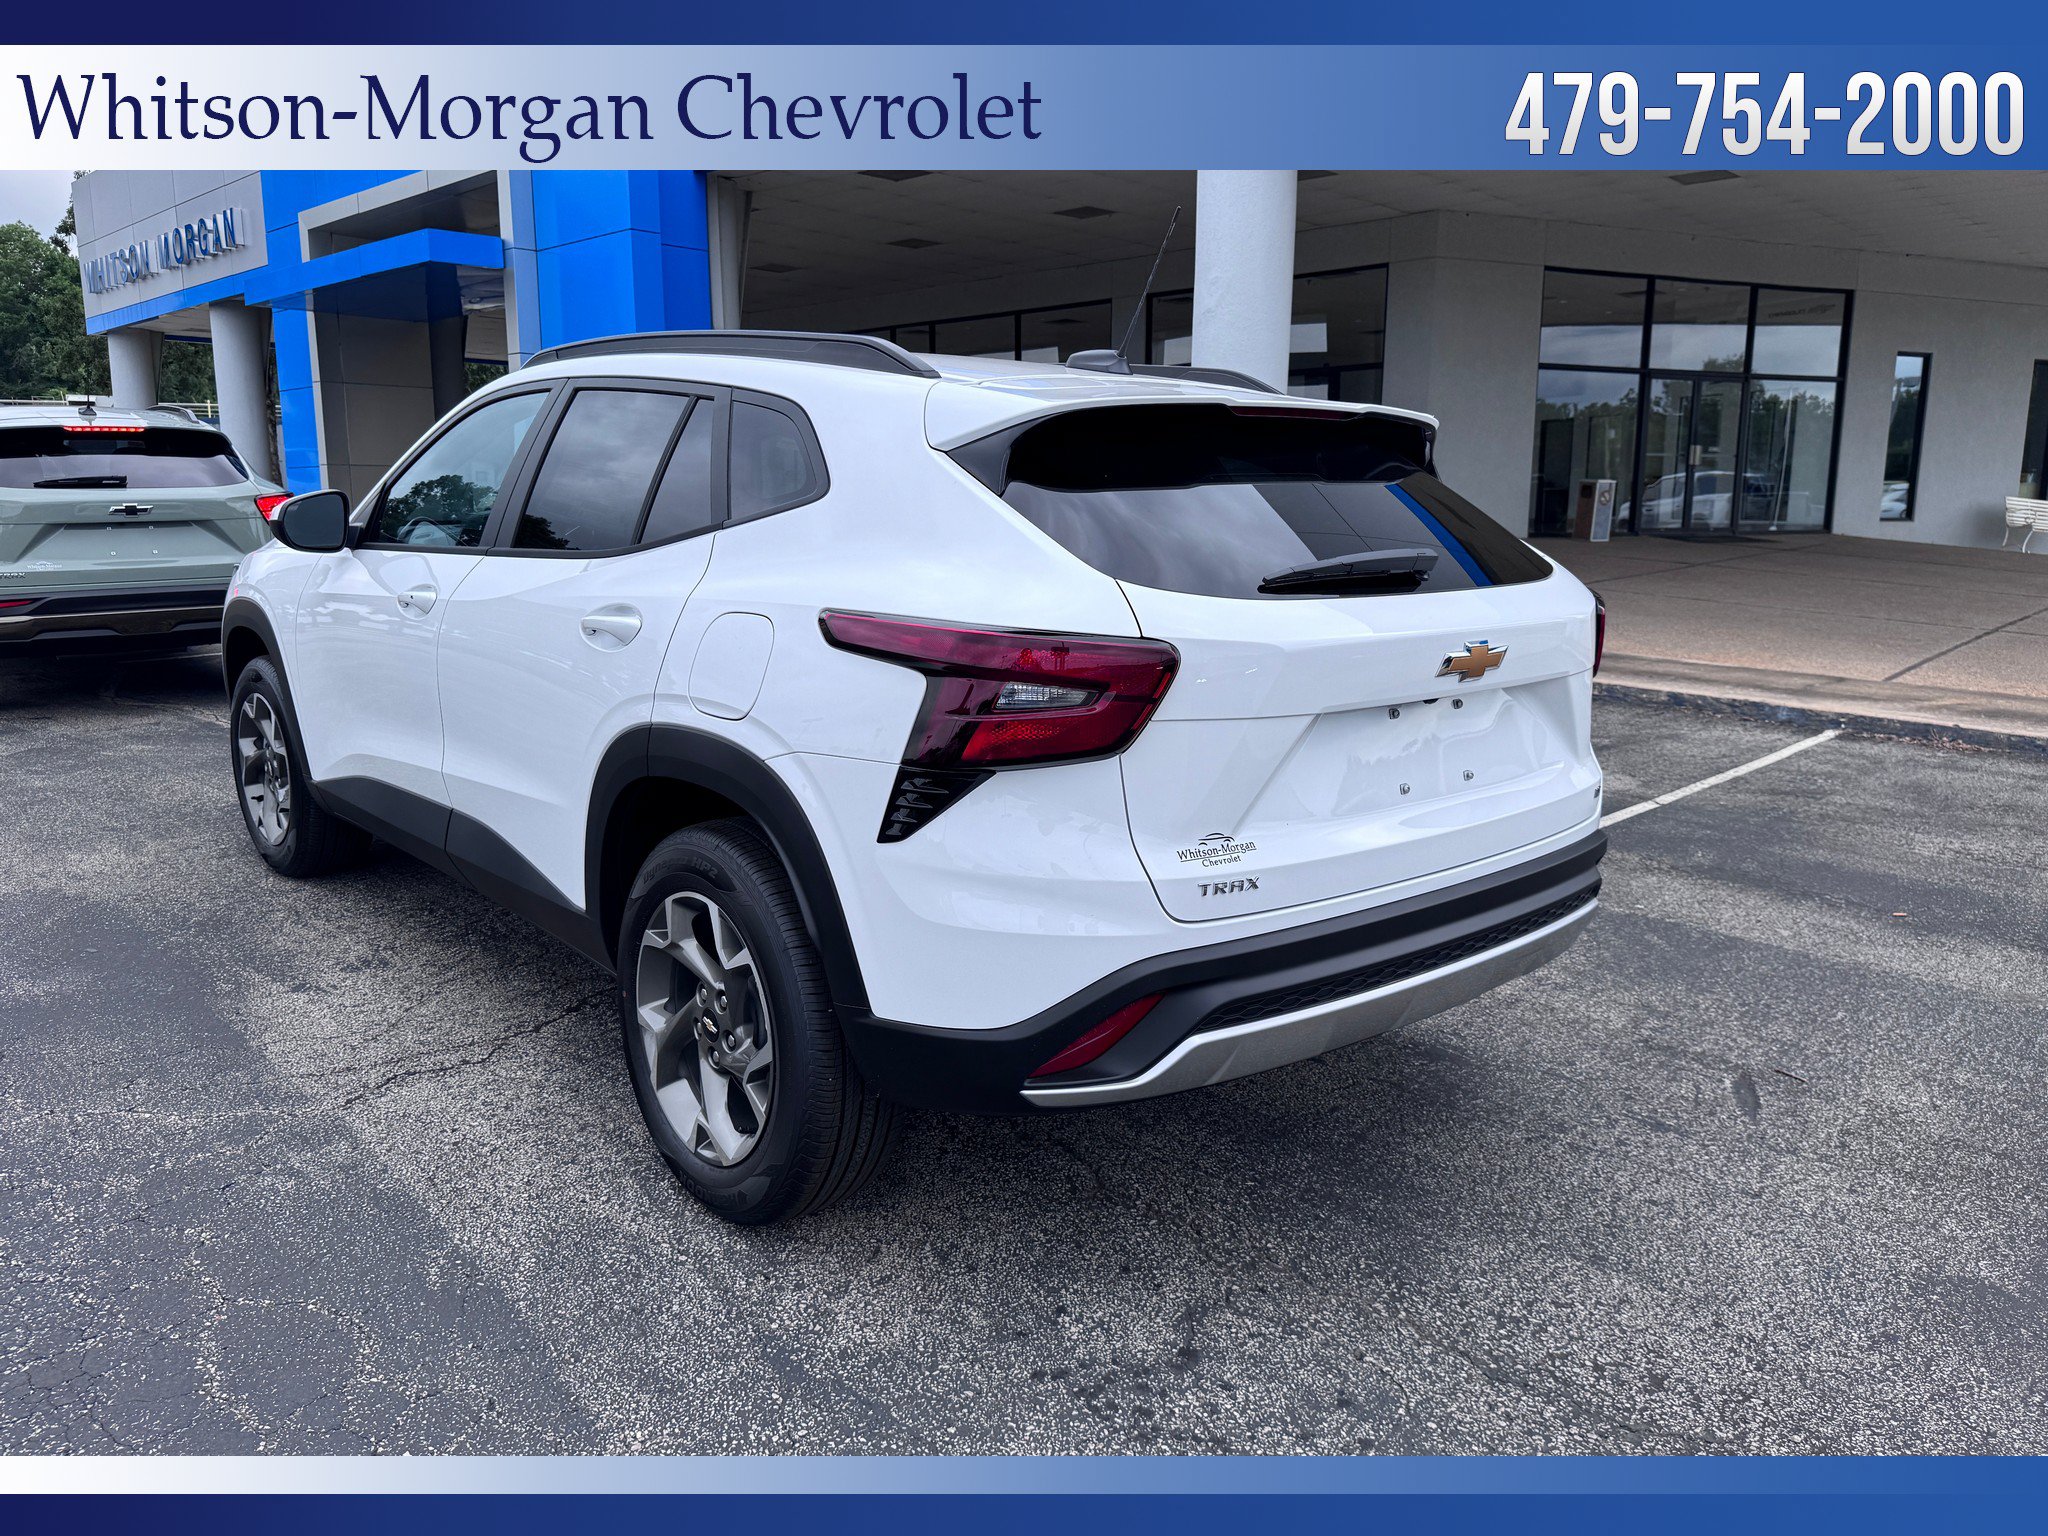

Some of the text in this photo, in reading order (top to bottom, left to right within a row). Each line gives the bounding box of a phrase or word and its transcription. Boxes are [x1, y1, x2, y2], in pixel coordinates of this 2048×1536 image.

[84, 207, 239, 294] WHITSON MORGAN
[1177, 841, 1255, 860] Whitson-Morgan
[691, 857, 718, 879] HP2
[1202, 855, 1241, 867] Chevrolet
[1198, 877, 1259, 896] TRAX
